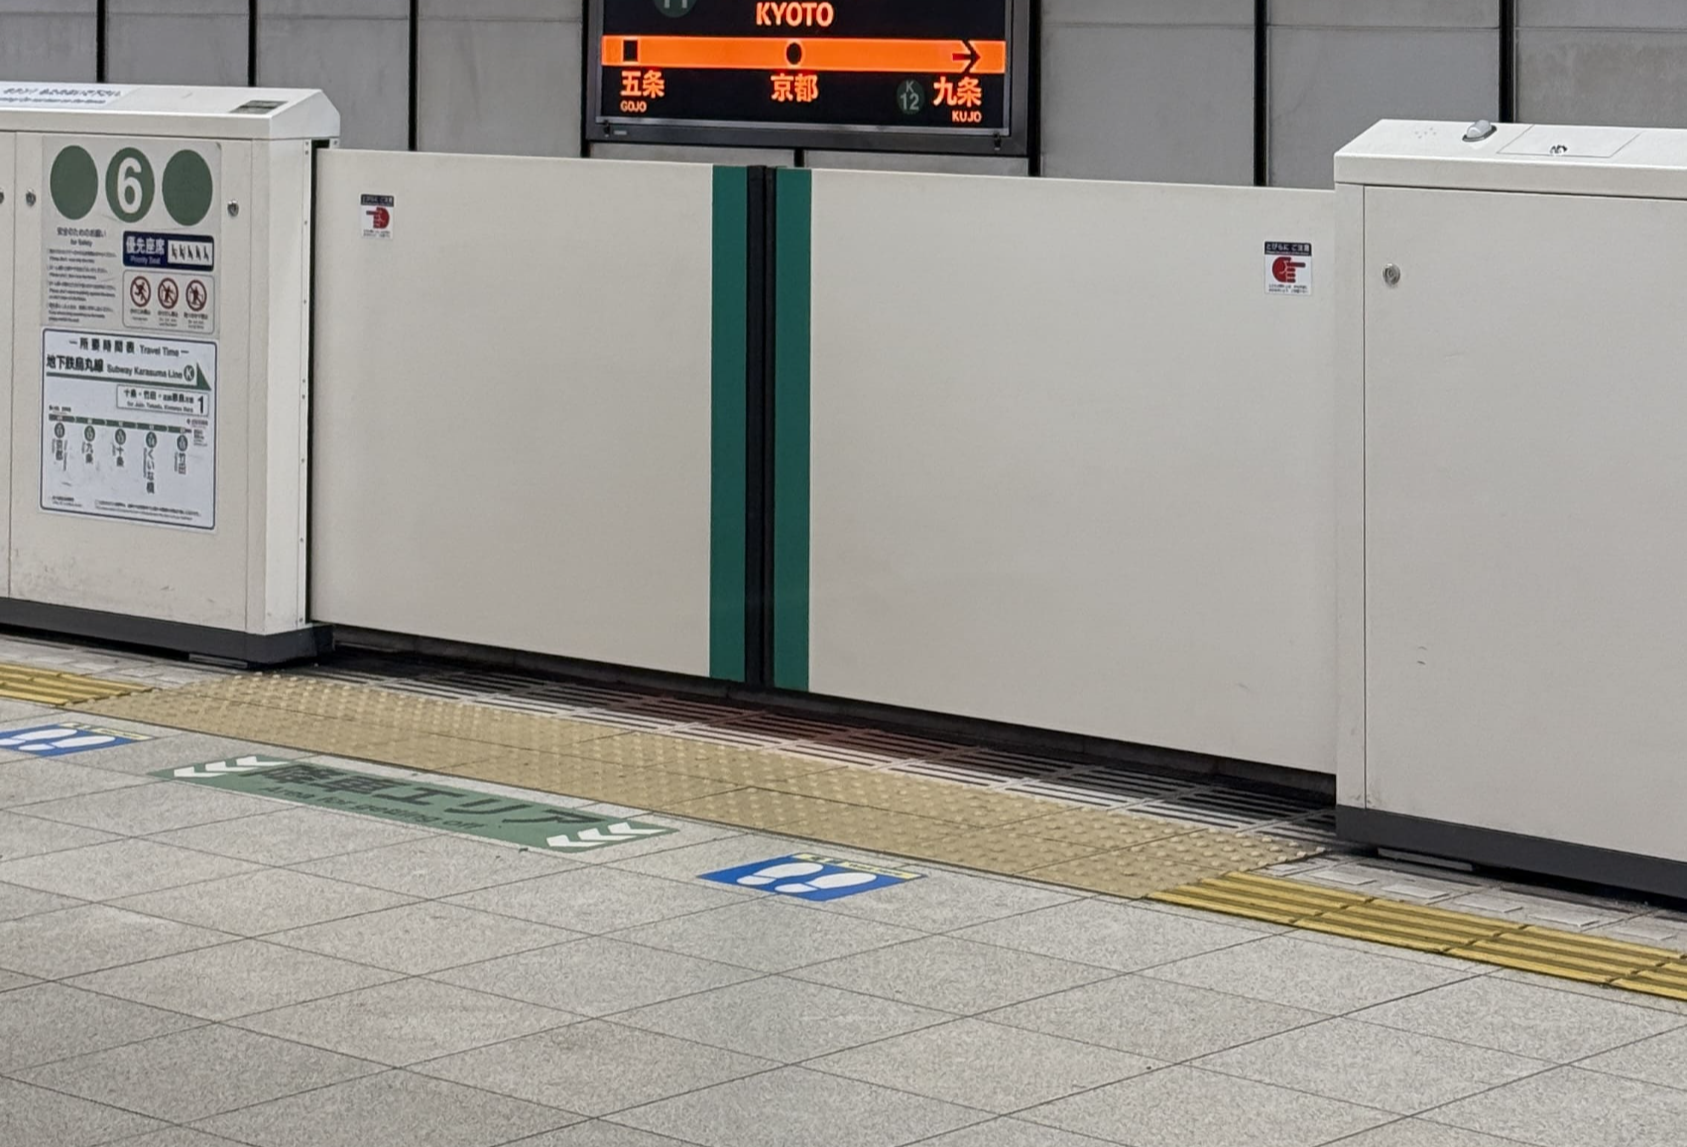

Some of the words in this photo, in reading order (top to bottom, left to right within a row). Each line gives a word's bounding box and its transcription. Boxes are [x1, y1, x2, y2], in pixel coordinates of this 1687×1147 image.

[756, 2, 834, 27] KYOTO
[620, 71, 665, 99] 五条
[770, 74, 819, 103] 京都
[905, 81, 915, 92] K
[933, 77, 982, 107] 九条
[620, 101, 648, 113] GOJO
[900, 93, 920, 111] 12
[952, 110, 983, 123] KUJO
[116, 156, 143, 213] 6
[126, 236, 165, 255] 優先座席
[139, 345, 160, 356] Travel
[162, 347, 179, 357] Time
[46, 355, 104, 373] 地下鉄烏丸線
[107, 364, 133, 376] Subway
[134, 366, 167, 378] Karasuma
[168, 369, 183, 380] Line
[239, 763, 606, 826] 降車エリア
